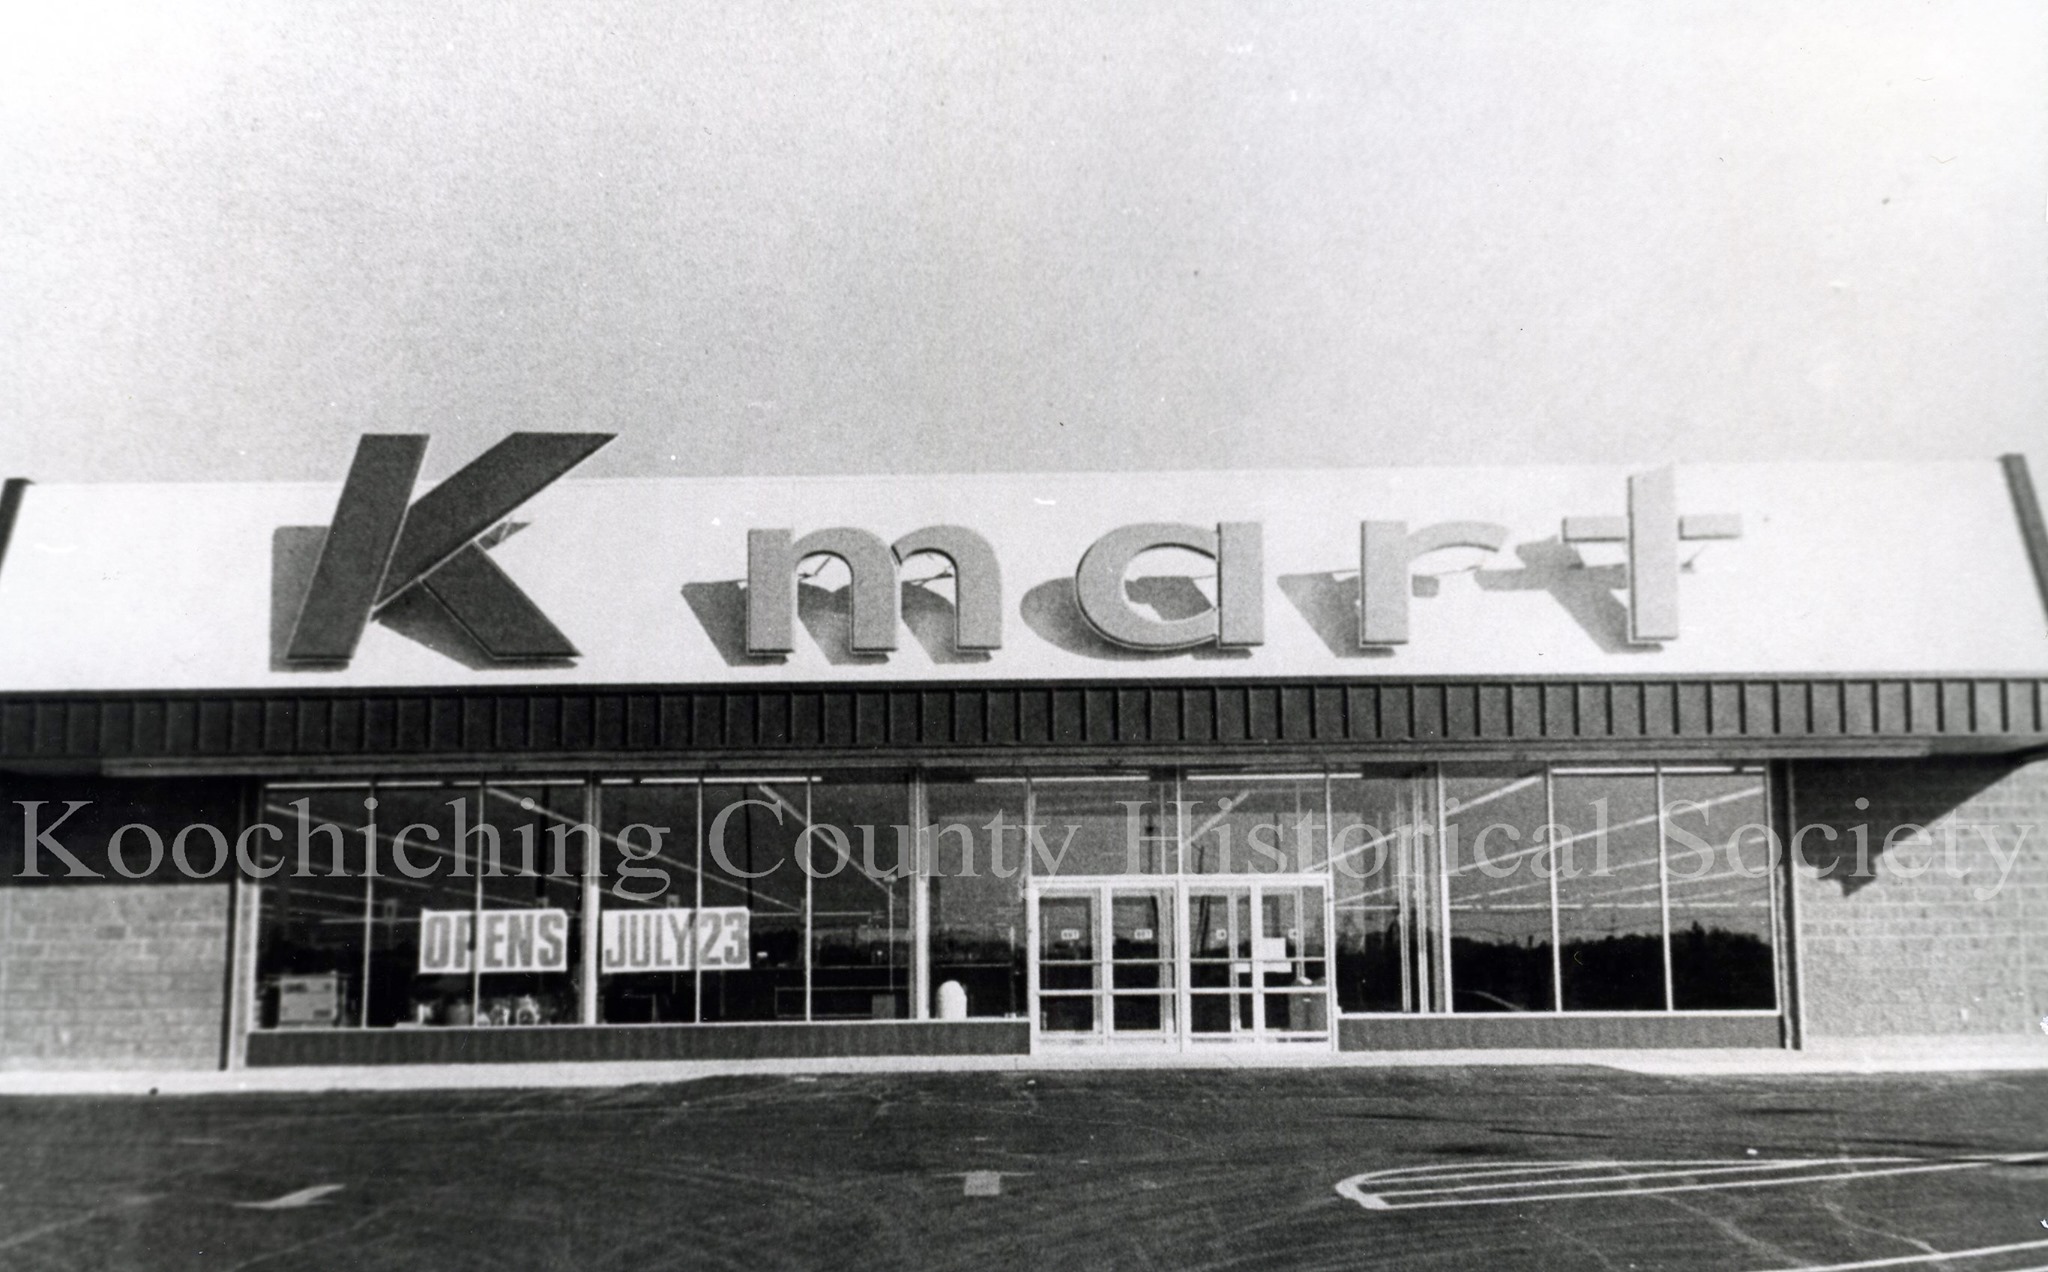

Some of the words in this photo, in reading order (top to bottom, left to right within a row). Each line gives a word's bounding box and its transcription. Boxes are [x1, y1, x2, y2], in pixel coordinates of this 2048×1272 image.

[423, 913, 565, 969] OPENS
[604, 913, 697, 967] JULY
[699, 911, 748, 966] 23
